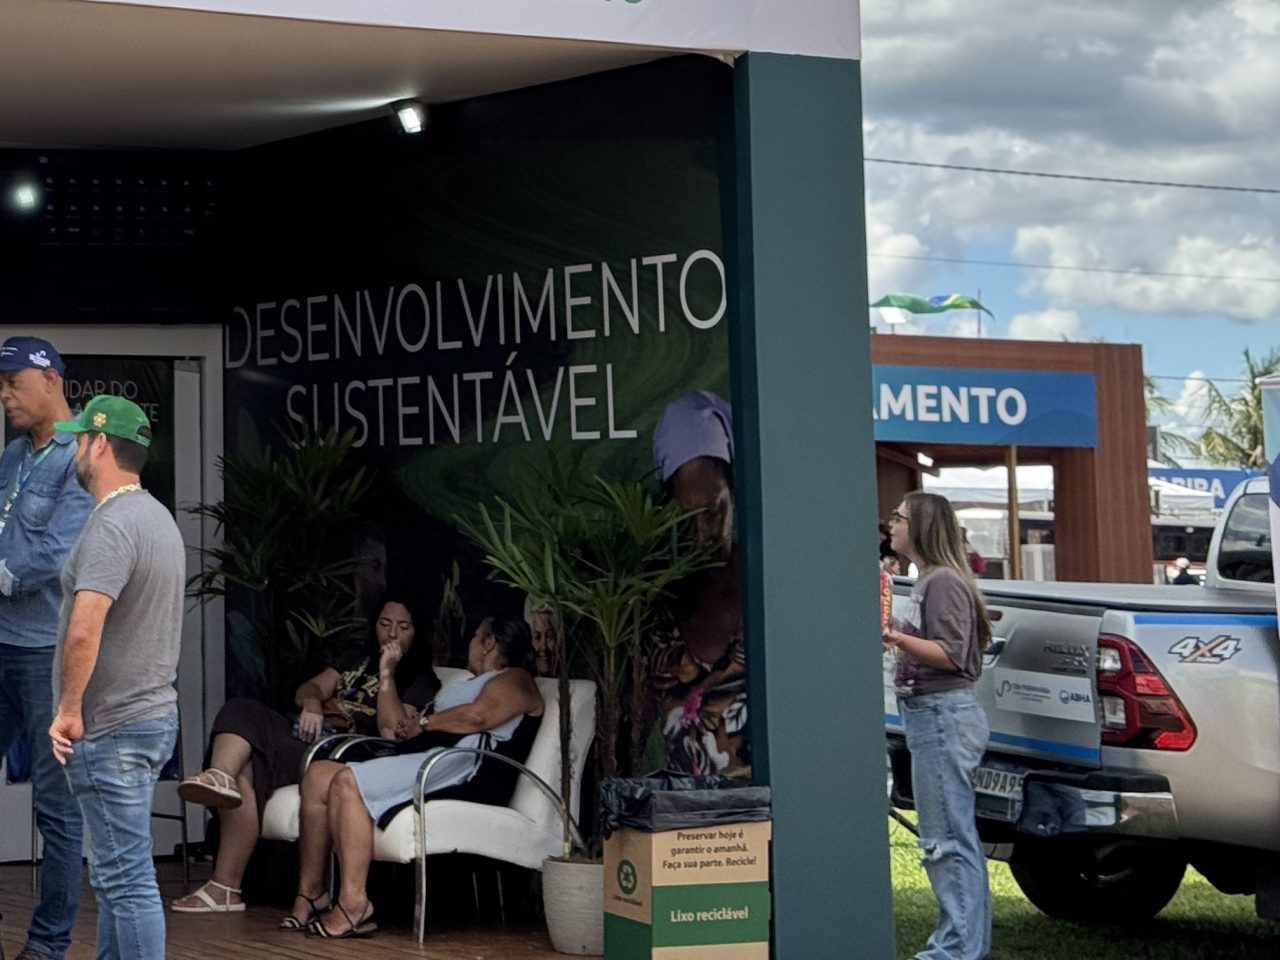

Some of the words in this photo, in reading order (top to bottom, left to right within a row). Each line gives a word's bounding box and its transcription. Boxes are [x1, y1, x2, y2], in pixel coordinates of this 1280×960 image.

[225, 249, 727, 369] DESENVOLVIMENTO
[111, 380, 138, 399] DO
[286, 351, 638, 449] SUSTENTÁVEL
[677, 831, 716, 841] Preservar
[718, 830, 738, 842] hoje
[738, 829, 744, 838] é
[670, 846, 705, 857] garantir
[662, 859, 682, 871] Faça
[683, 861, 698, 869] sua
[699, 859, 723, 870] parte.
[725, 857, 757, 867] Recicle!
[671, 910, 694, 922] Lixo
[697, 907, 748, 921] reciclável
